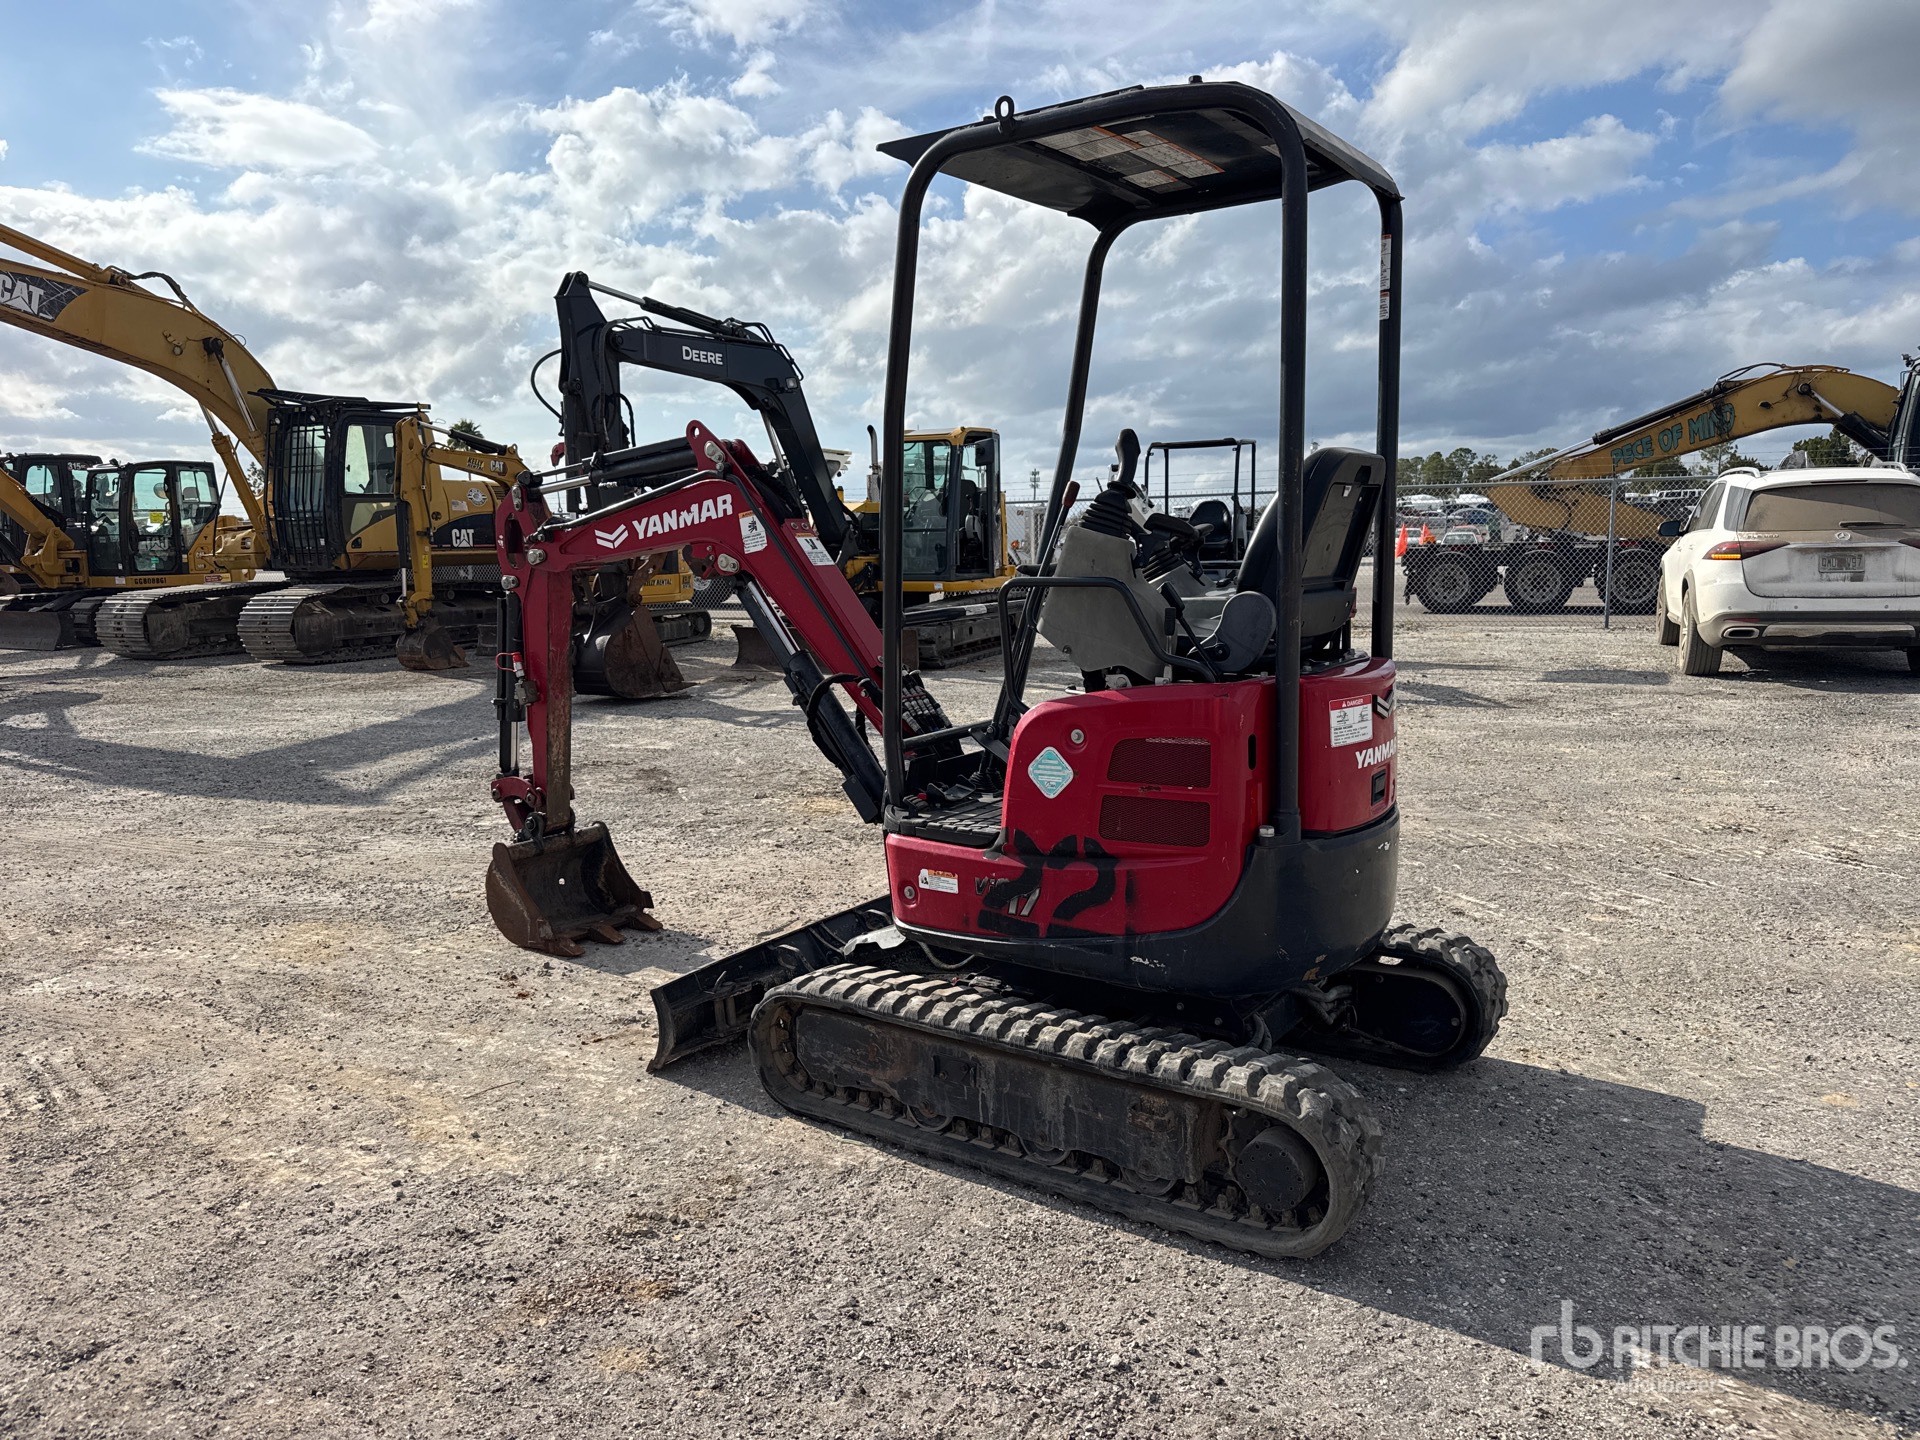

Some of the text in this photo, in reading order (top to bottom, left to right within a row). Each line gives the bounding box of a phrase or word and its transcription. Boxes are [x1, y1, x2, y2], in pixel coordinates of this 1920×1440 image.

[0, 274, 44, 315] CAT
[682, 345, 723, 365] DEERE
[1658, 423, 1682, 453] OF
[490, 460, 504, 473] CAT
[632, 494, 733, 540] YANMAR
[451, 528, 474, 548] CAT
[1346, 698, 1363, 707] DANGER
